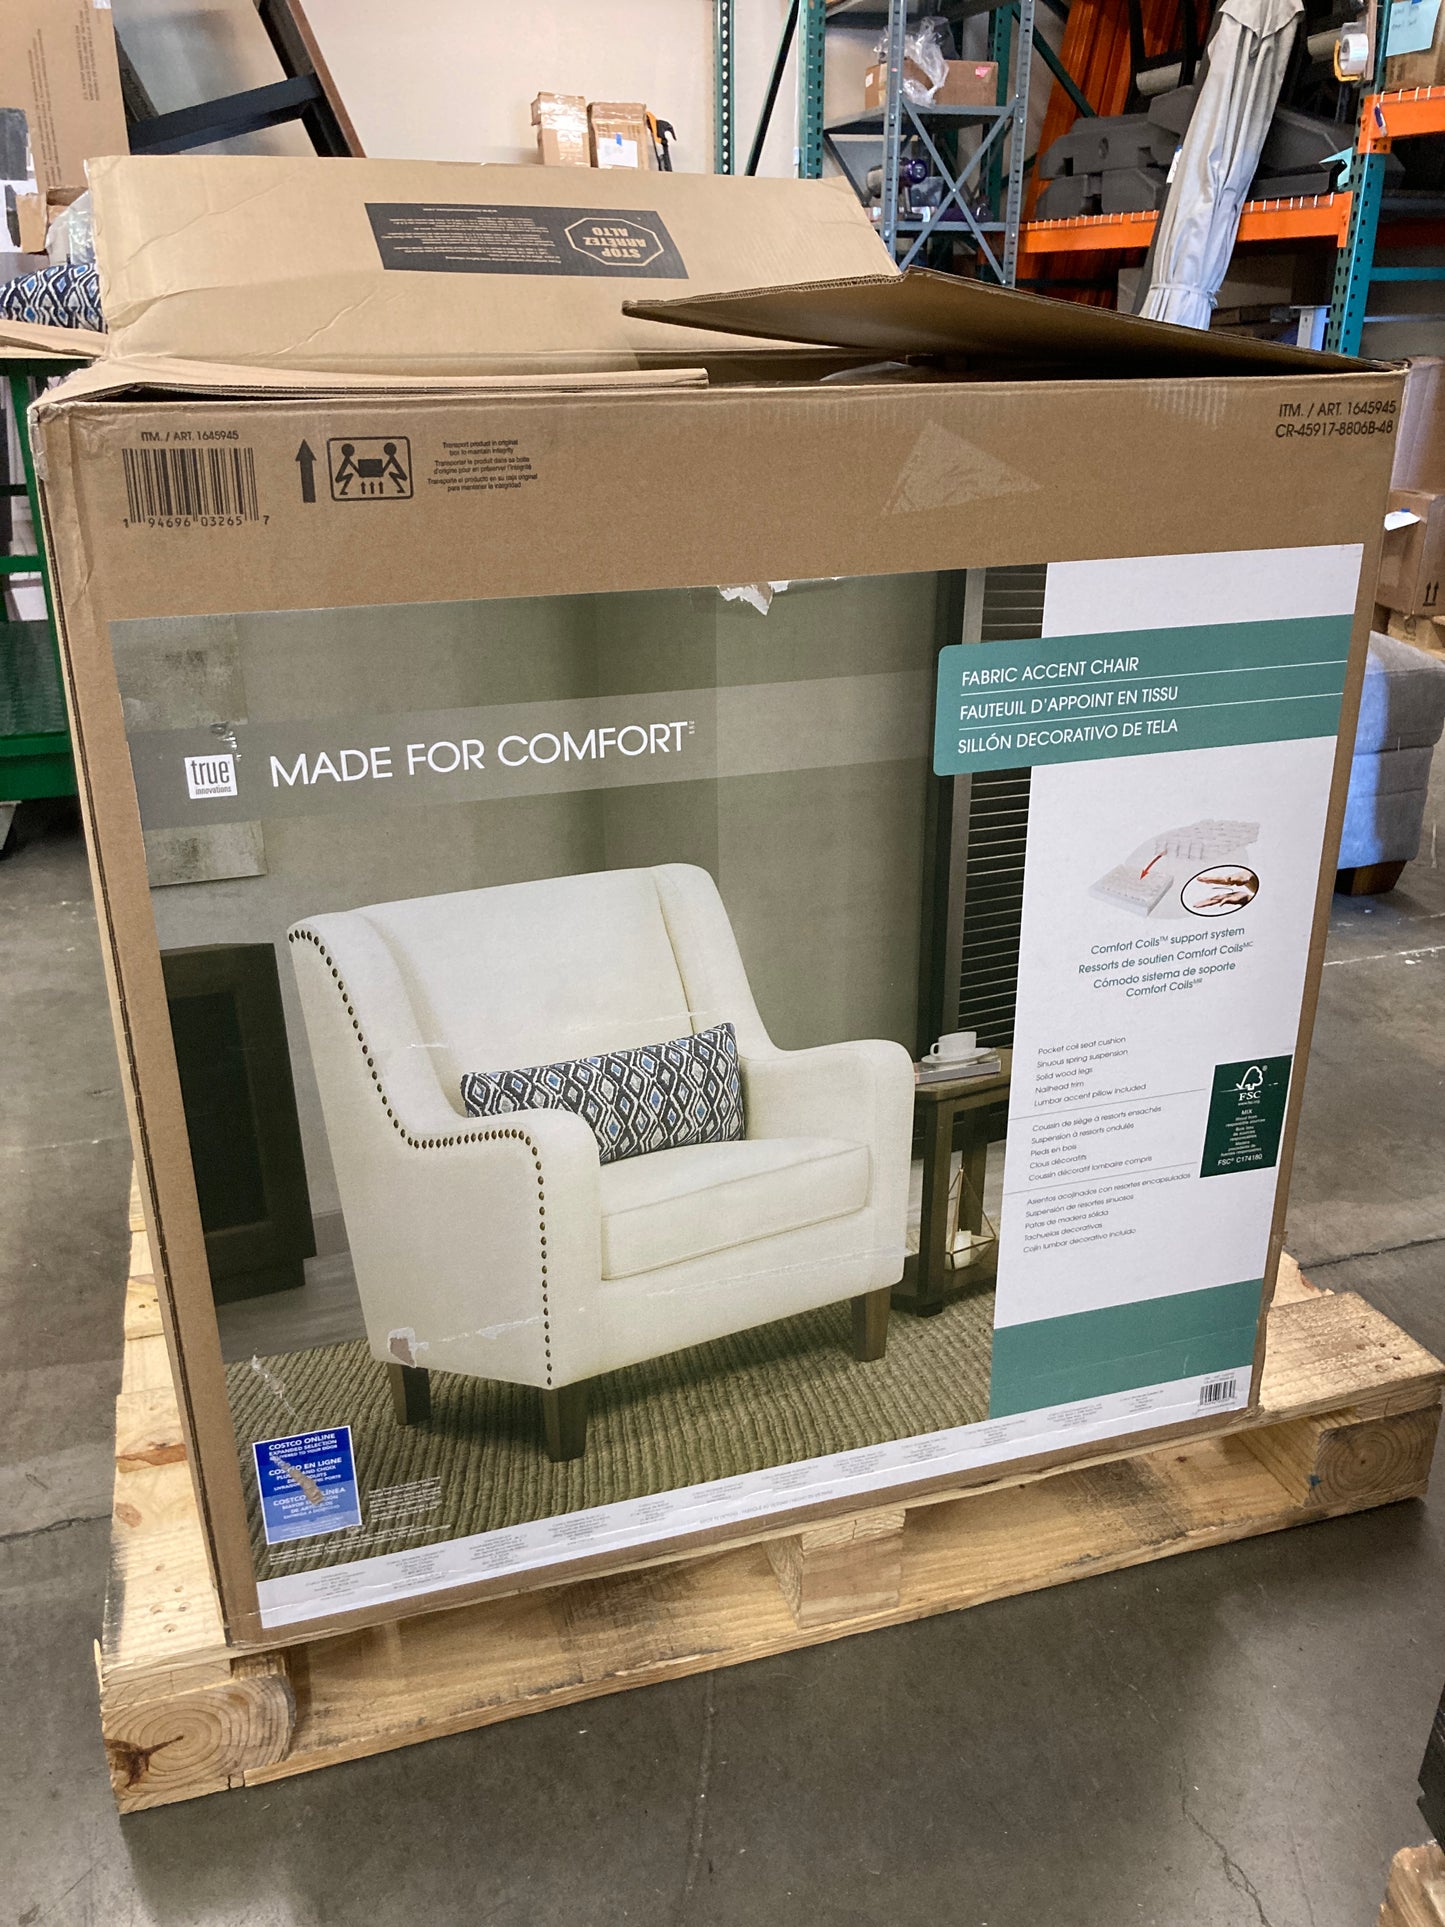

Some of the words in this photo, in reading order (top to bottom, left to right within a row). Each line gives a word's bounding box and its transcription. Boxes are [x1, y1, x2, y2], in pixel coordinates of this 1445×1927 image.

[591, 227, 629, 237] ALTO
[582, 237, 647, 248] ARRÊTEZ
[601, 248, 641, 258] STOP
[1279, 403, 1303, 417] ITM.
[1307, 403, 1315, 418] /
[1317, 402, 1342, 416] ART.
[1347, 400, 1397, 415] 1645945
[141, 432, 162, 442] ITM.
[173, 431, 195, 441] ART.
[198, 430, 239, 440] 1645945
[1275, 420, 1393, 438] CR-45917-8806B-48
[492, 447, 513, 455] integrity
[474, 458, 493, 466] produit
[427, 478, 457, 486] Transporte
[465, 476, 488, 484] producto
[518, 473, 538, 481] original
[494, 482, 522, 491] integridad
[148, 517, 191, 528] 94696
[201, 516, 243, 527] 03265
[262, 515, 270, 525] 7
[962, 667, 1018, 687] FABRIC
[1021, 661, 1088, 681] ACCENT
[1090, 656, 1139, 675] CHAIR
[960, 700, 1027, 721] FAUTEUIL
[1031, 691, 1114, 714] D'APPOINT
[1117, 689, 1138, 705] EN
[1141, 685, 1179, 703] TISSU
[958, 732, 1012, 754] SILLÓN
[1016, 724, 1118, 748] DECORATIVO
[1122, 721, 1143, 737] DE
[1146, 718, 1178, 735] TELA
[269, 746, 393, 788] MADE
[406, 738, 485, 776] FOR
[497, 721, 688, 767] COMFORT
[191, 760, 230, 785] true
[196, 786, 232, 795] innovations
[1091, 941, 1133, 955] Comfort
[1170, 932, 1209, 945] support
[1210, 927, 1245, 941] system
[1078, 961, 1119, 974] Ressorts
[1121, 957, 1136, 968] de
[1138, 953, 1174, 966] soutien
[1177, 946, 1218, 961] Comfort
[1093, 975, 1140, 989] Cómodo
[1142, 970, 1180, 983] sistema
[1182, 966, 1197, 977] de
[1198, 962, 1236, 976] soporte
[1125, 984, 1167, 998] Comfort
[1038, 1045, 1064, 1055] Pocket
[1065, 1043, 1079, 1051] coil
[1080, 1040, 1097, 1049] seat
[1098, 1036, 1126, 1047] cushion
[1037, 1058, 1065, 1068] Sinuous
[1066, 1054, 1088, 1065] spring
[1089, 1048, 1128, 1061] suspension
[1035, 1072, 1054, 1082] Solid
[1054, 1069, 1077, 1079] wood
[1078, 1066, 1093, 1076] legs
[1034, 1096, 1062, 1107] Lumbar
[1063, 1092, 1091, 1102] accent
[1091, 1089, 1113, 1099] pillow
[1114, 1083, 1147, 1094] included
[1035, 1083, 1069, 1094] Nailhead
[1070, 1080, 1085, 1089] trim
[1239, 1090, 1262, 1101] FSC
[1032, 1121, 1060, 1132] Coussin
[1061, 1119, 1072, 1128] de
[1100, 1111, 1126, 1121] ressorts
[1031, 1133, 1071, 1145] Suspension
[1079, 1128, 1105, 1137] ressorts
[1030, 1148, 1050, 1157] Pieds
[1051, 1146, 1061, 1154] en
[1062, 1143, 1077, 1152] bois
[1028, 1171, 1056, 1182] Coussin
[1057, 1164, 1091, 1177] décoratif
[1092, 1160, 1123, 1171] lombaire
[1124, 1155, 1153, 1166] compris
[1029, 1159, 1050, 1169] Clous
[1051, 1154, 1087, 1166] décoratifs
[1026, 1195, 1057, 1206] Asientos
[1057, 1188, 1097, 1201] acojinados
[1098, 1186, 1113, 1194] con
[1114, 1181, 1141, 1191] resortes
[1141, 1172, 1191, 1186] encapsulados
[1066, 1202, 1077, 1210] de
[1077, 1199, 1105, 1209] resortes
[1105, 1193, 1134, 1204] sinuosos
[1024, 1220, 1045, 1230] Patas
[1046, 1218, 1057, 1226] de
[1057, 1213, 1087, 1224] madera
[1024, 1230, 1060, 1241] Tachuelas
[1060, 1222, 1103, 1235] decorativas
[1043, 1239, 1068, 1249] lumbar
[1069, 1232, 1108, 1245] decorativo
[268, 1440, 302, 1451] COSTCO
[304, 1433, 336, 1444] ONLINE
[269, 1447, 303, 1457] EXPANDED
[304, 1440, 337, 1450] SELECTION
[317, 1457, 342, 1467] LIGNE
[273, 1494, 306, 1506] COSTCO
